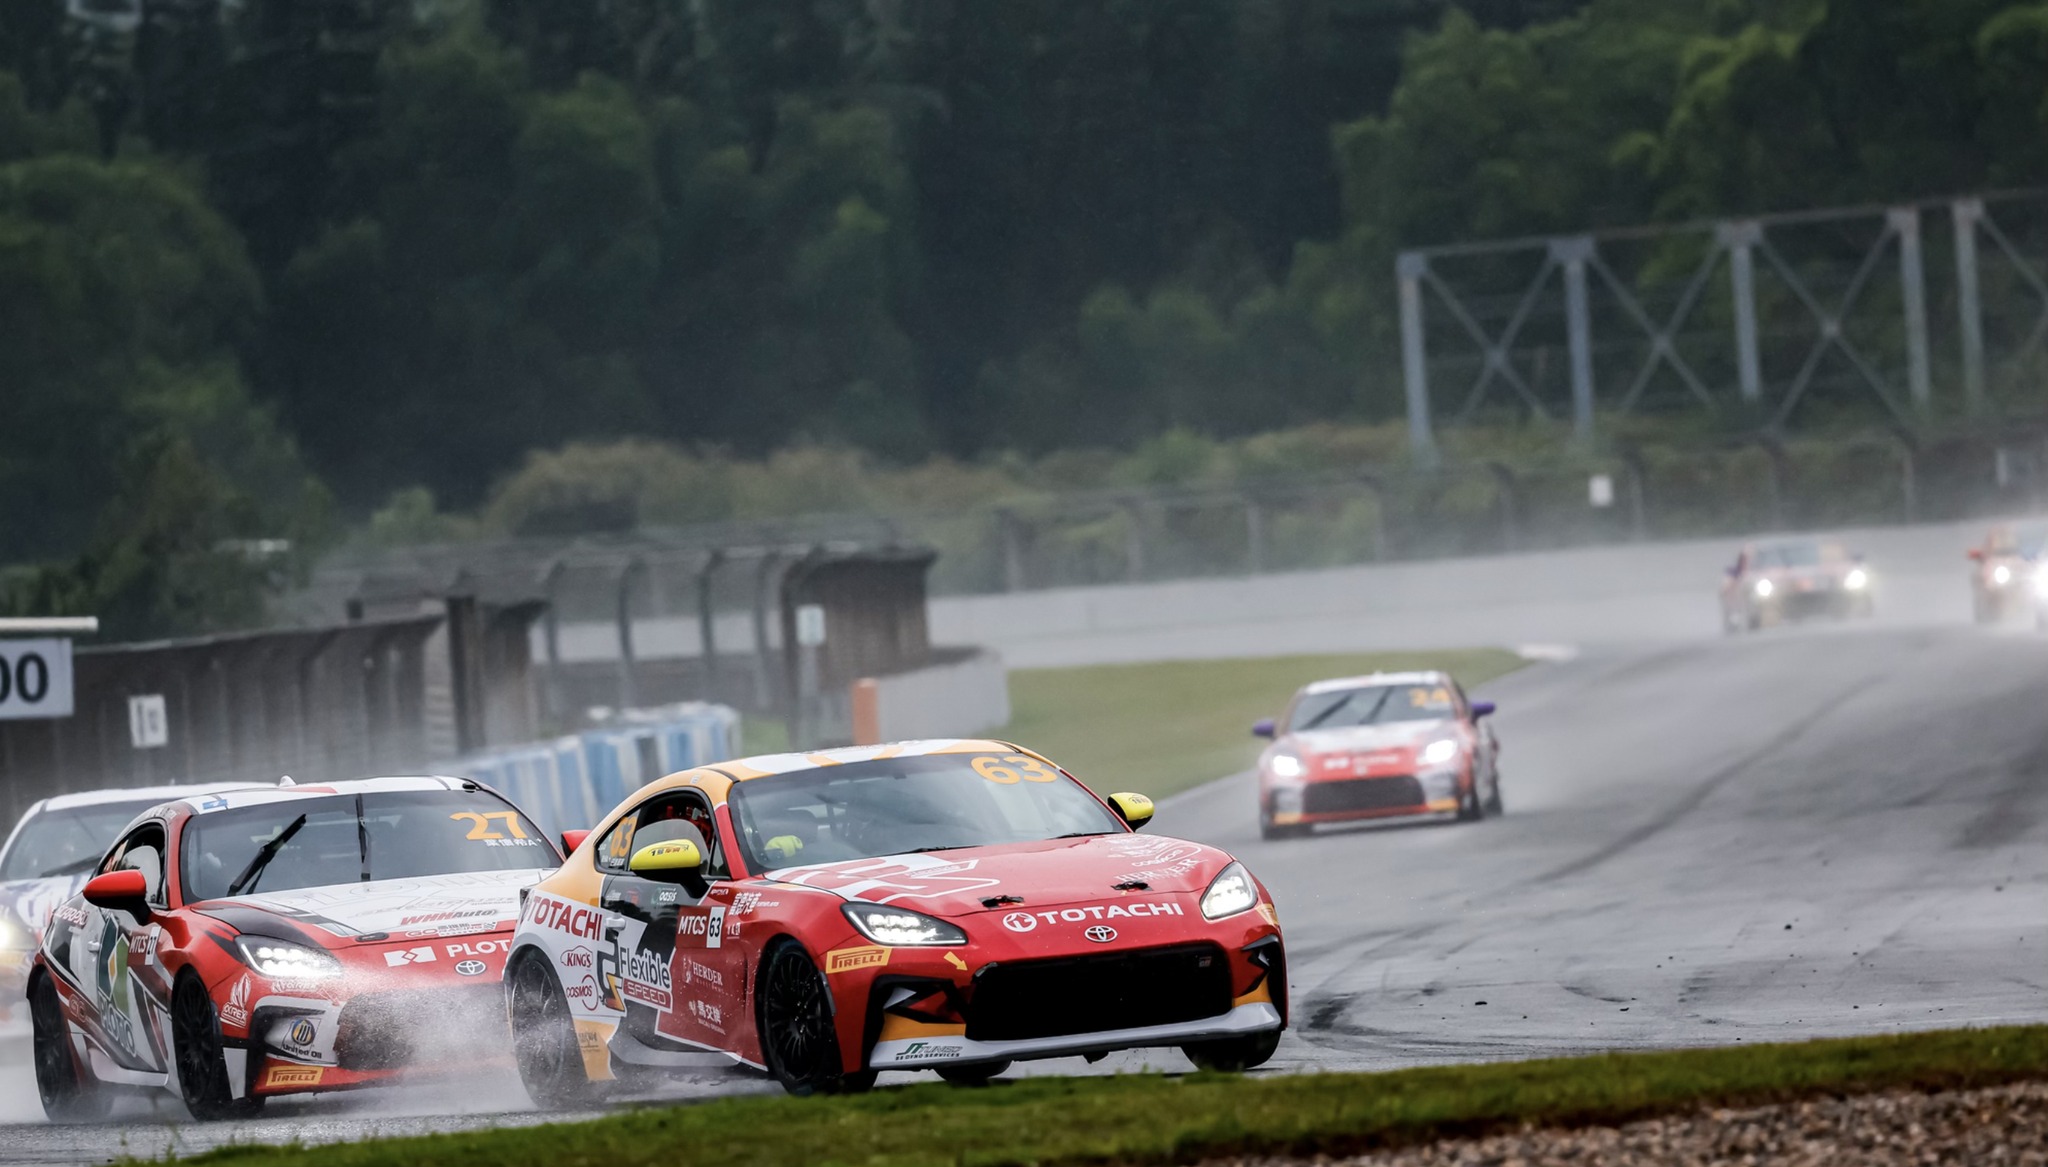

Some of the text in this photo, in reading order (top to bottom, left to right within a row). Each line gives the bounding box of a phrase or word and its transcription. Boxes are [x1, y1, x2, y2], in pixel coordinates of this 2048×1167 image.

[970, 756, 1058, 785] 63
[449, 810, 528, 841] 27
[610, 816, 638, 857] 63
[1131, 849, 1184, 867] COSMOS
[528, 895, 603, 942] TOTACHI
[1036, 902, 1184, 925] TOTACHI
[678, 915, 708, 936] MTCS
[708, 916, 722, 938] 63
[129, 935, 157, 956] MTCS 27
[445, 939, 512, 958] PLOT
[566, 952, 593, 968] KING'S
[619, 947, 671, 990] Flexible
[831, 949, 885, 969] PIRELLI
[693, 961, 724, 986] HERDER
[566, 985, 593, 998] COSMOS
[626, 982, 667, 1006] SPEED
[282, 1043, 309, 1057] United
[271, 1070, 318, 1082] PIRELLI
